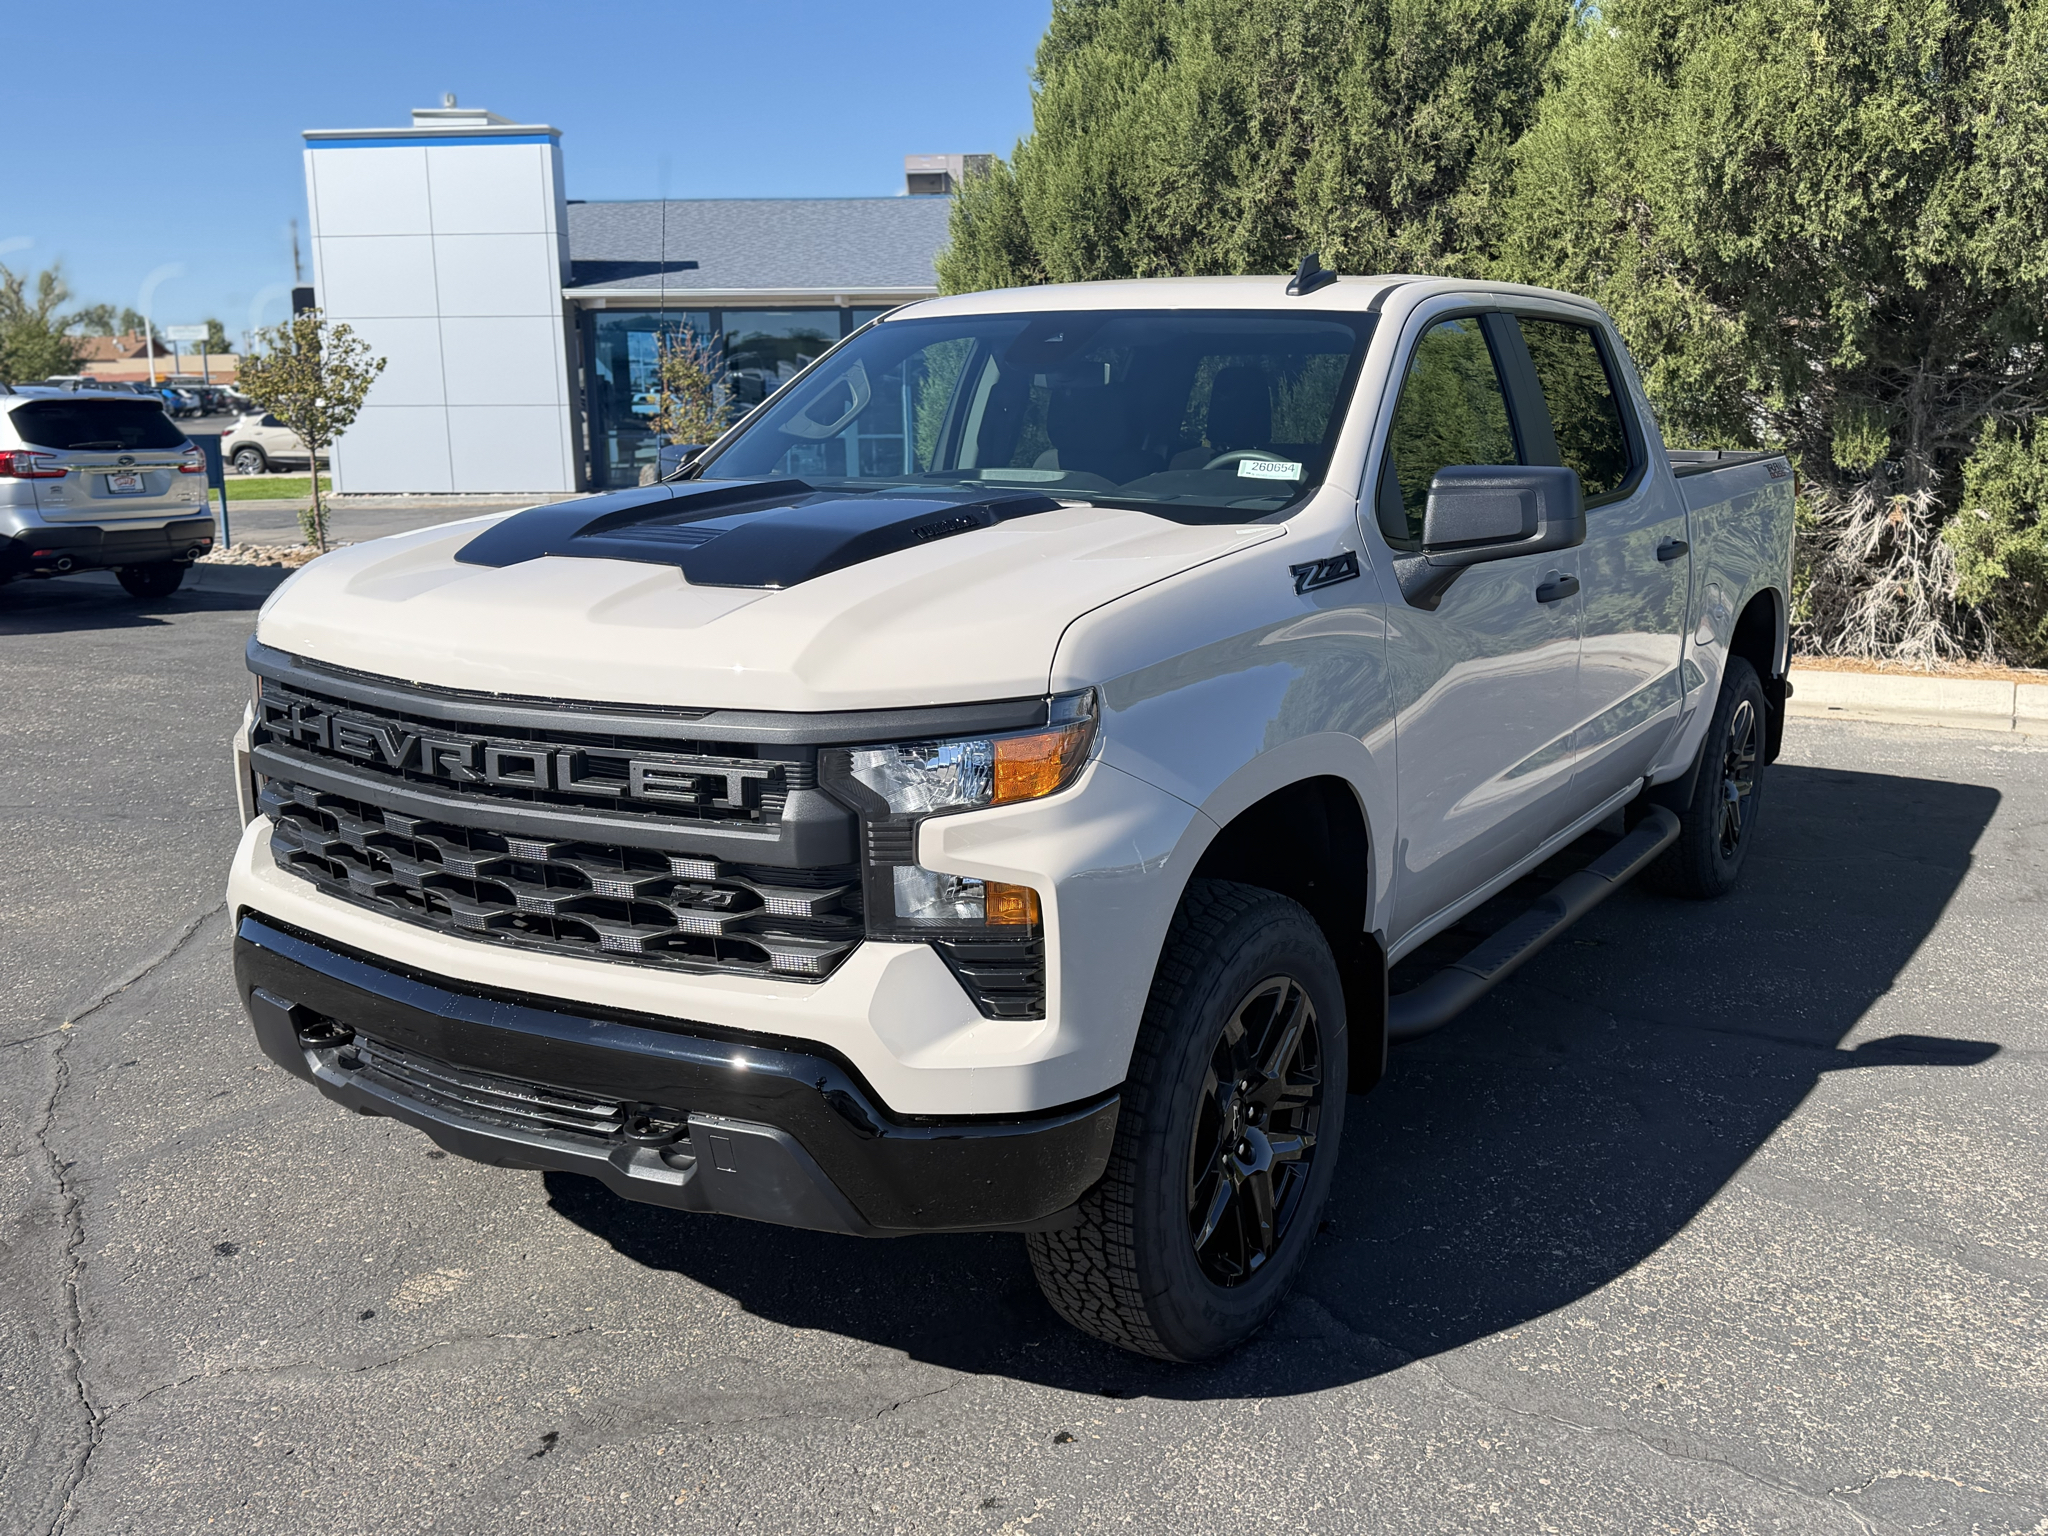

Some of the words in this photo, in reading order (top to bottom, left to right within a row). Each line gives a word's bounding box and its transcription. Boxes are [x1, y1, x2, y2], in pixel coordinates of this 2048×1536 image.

[1251, 461, 1296, 472] 260654
[1288, 550, 1361, 597] Z71
[260, 694, 784, 809] CHEVROLET
